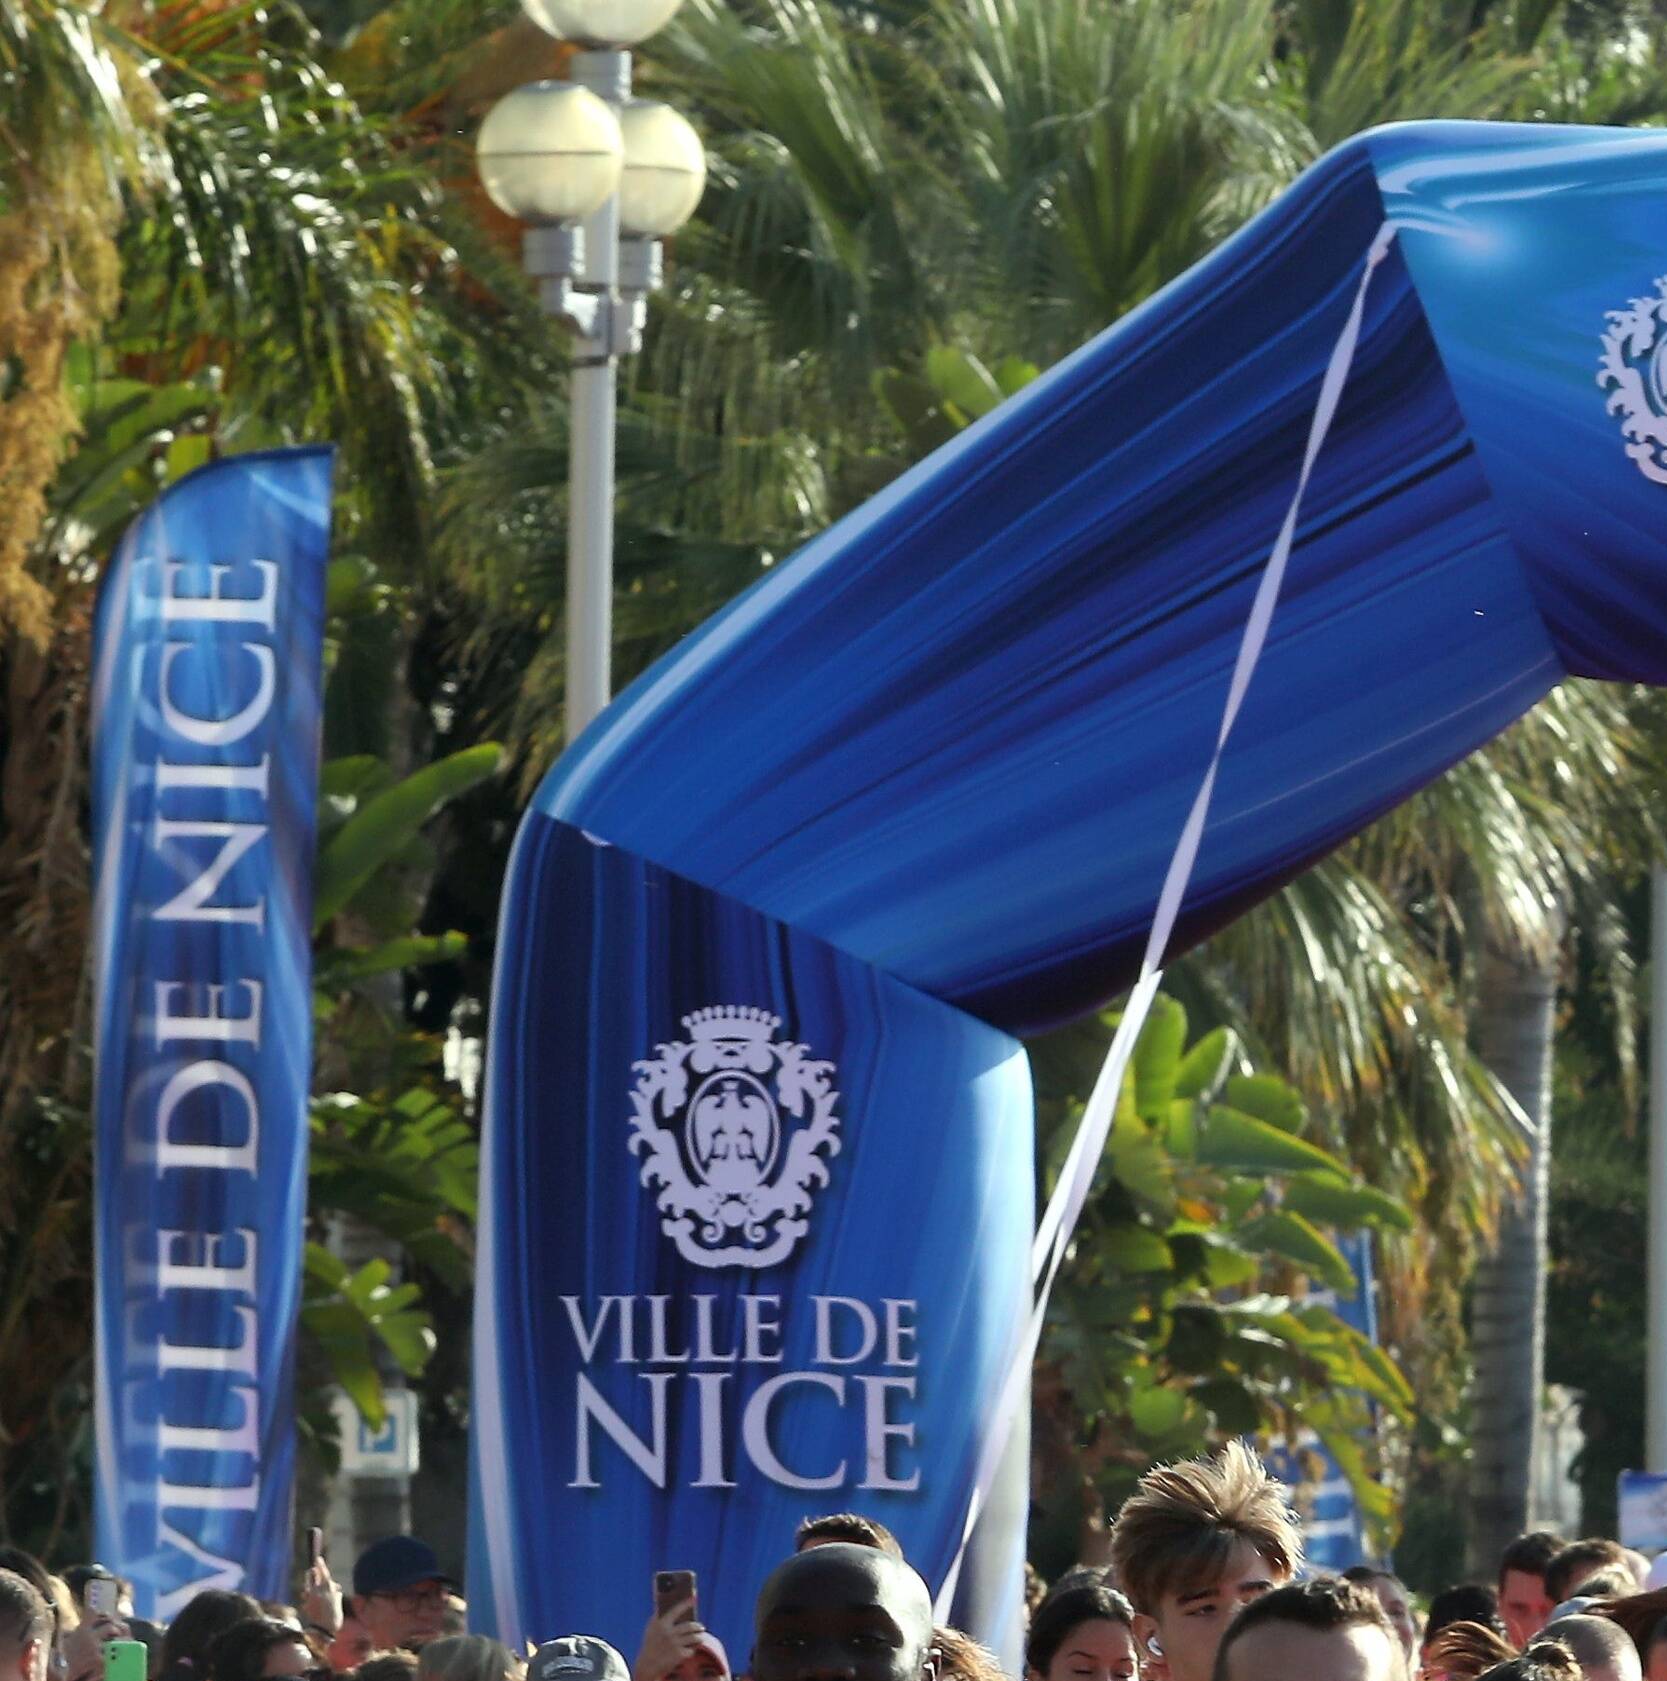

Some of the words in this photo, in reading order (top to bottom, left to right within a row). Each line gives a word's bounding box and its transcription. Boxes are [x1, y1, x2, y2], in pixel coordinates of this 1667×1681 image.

[151, 559, 279, 936] NICE
[155, 978, 264, 1179] DE
[153, 1227, 260, 1621] VILLE
[558, 1293, 784, 1365] VILLE
[808, 1295, 920, 1368] DE
[566, 1371, 921, 1491] NICE
